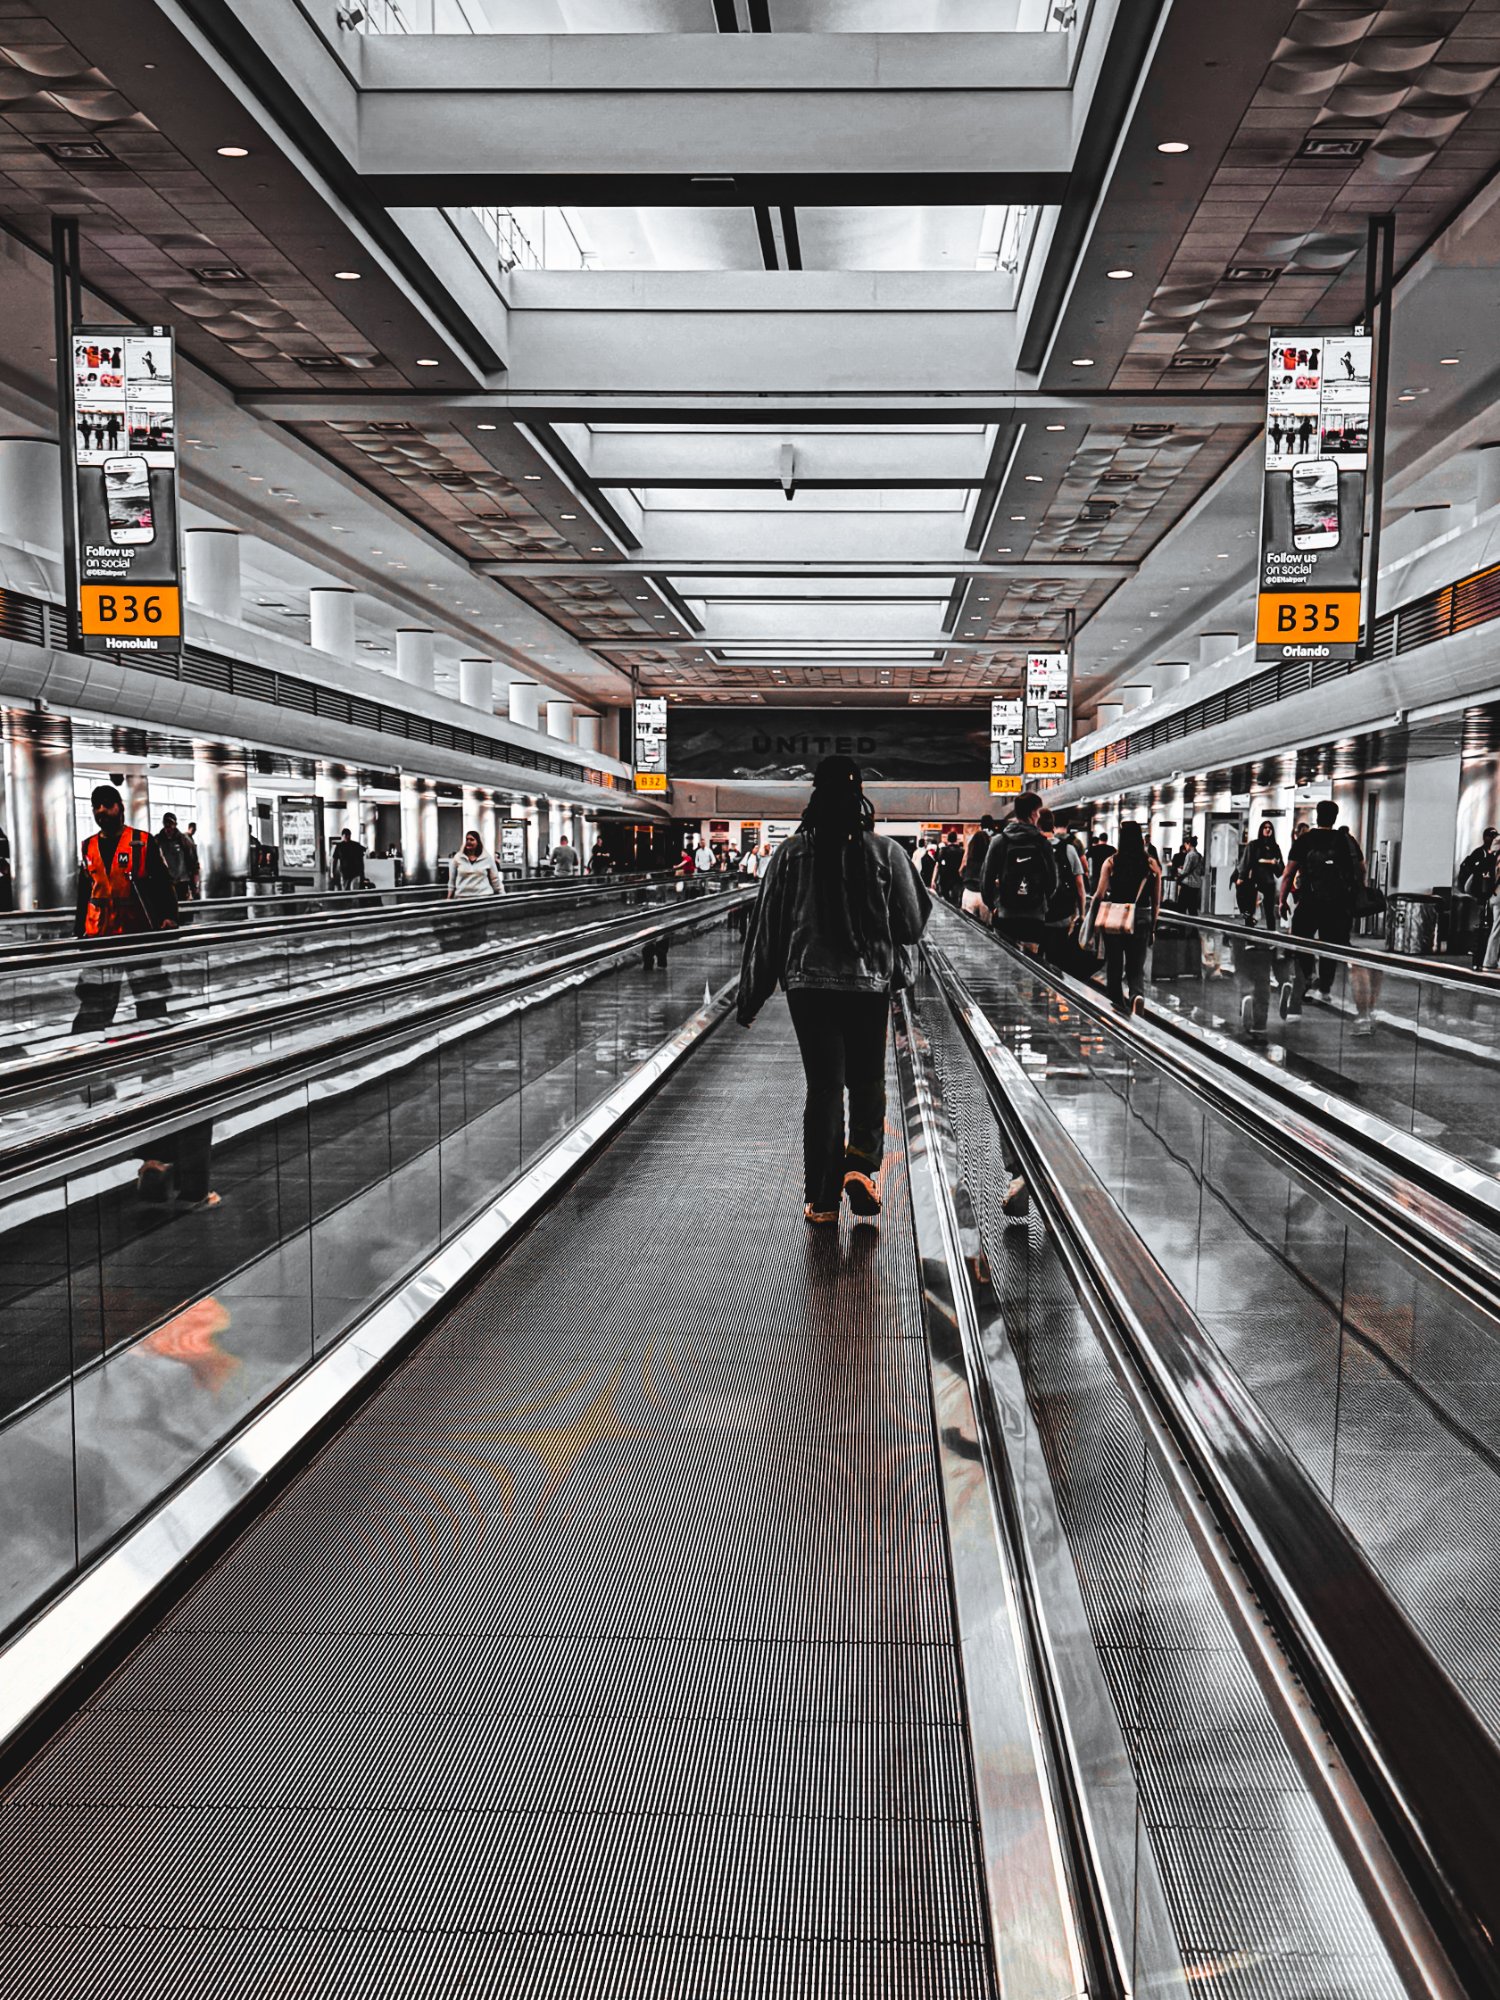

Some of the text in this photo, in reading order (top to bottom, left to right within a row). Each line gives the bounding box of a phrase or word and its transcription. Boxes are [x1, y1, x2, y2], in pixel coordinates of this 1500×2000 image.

[86, 546, 135, 558] Follow us
[86, 558, 130, 568] on social
[1267, 553, 1317, 563] Follow us
[1266, 564, 1312, 575] on social
[99, 595, 162, 623] B36
[1278, 604, 1340, 632] B35
[106, 638, 158, 649] Honolulu
[1282, 645, 1330, 657] Orlando
[752, 736, 876, 754] UNITED
[1033, 757, 1057, 768] B33
[641, 777, 660, 787] B32
[997, 779, 1014, 788] B31
